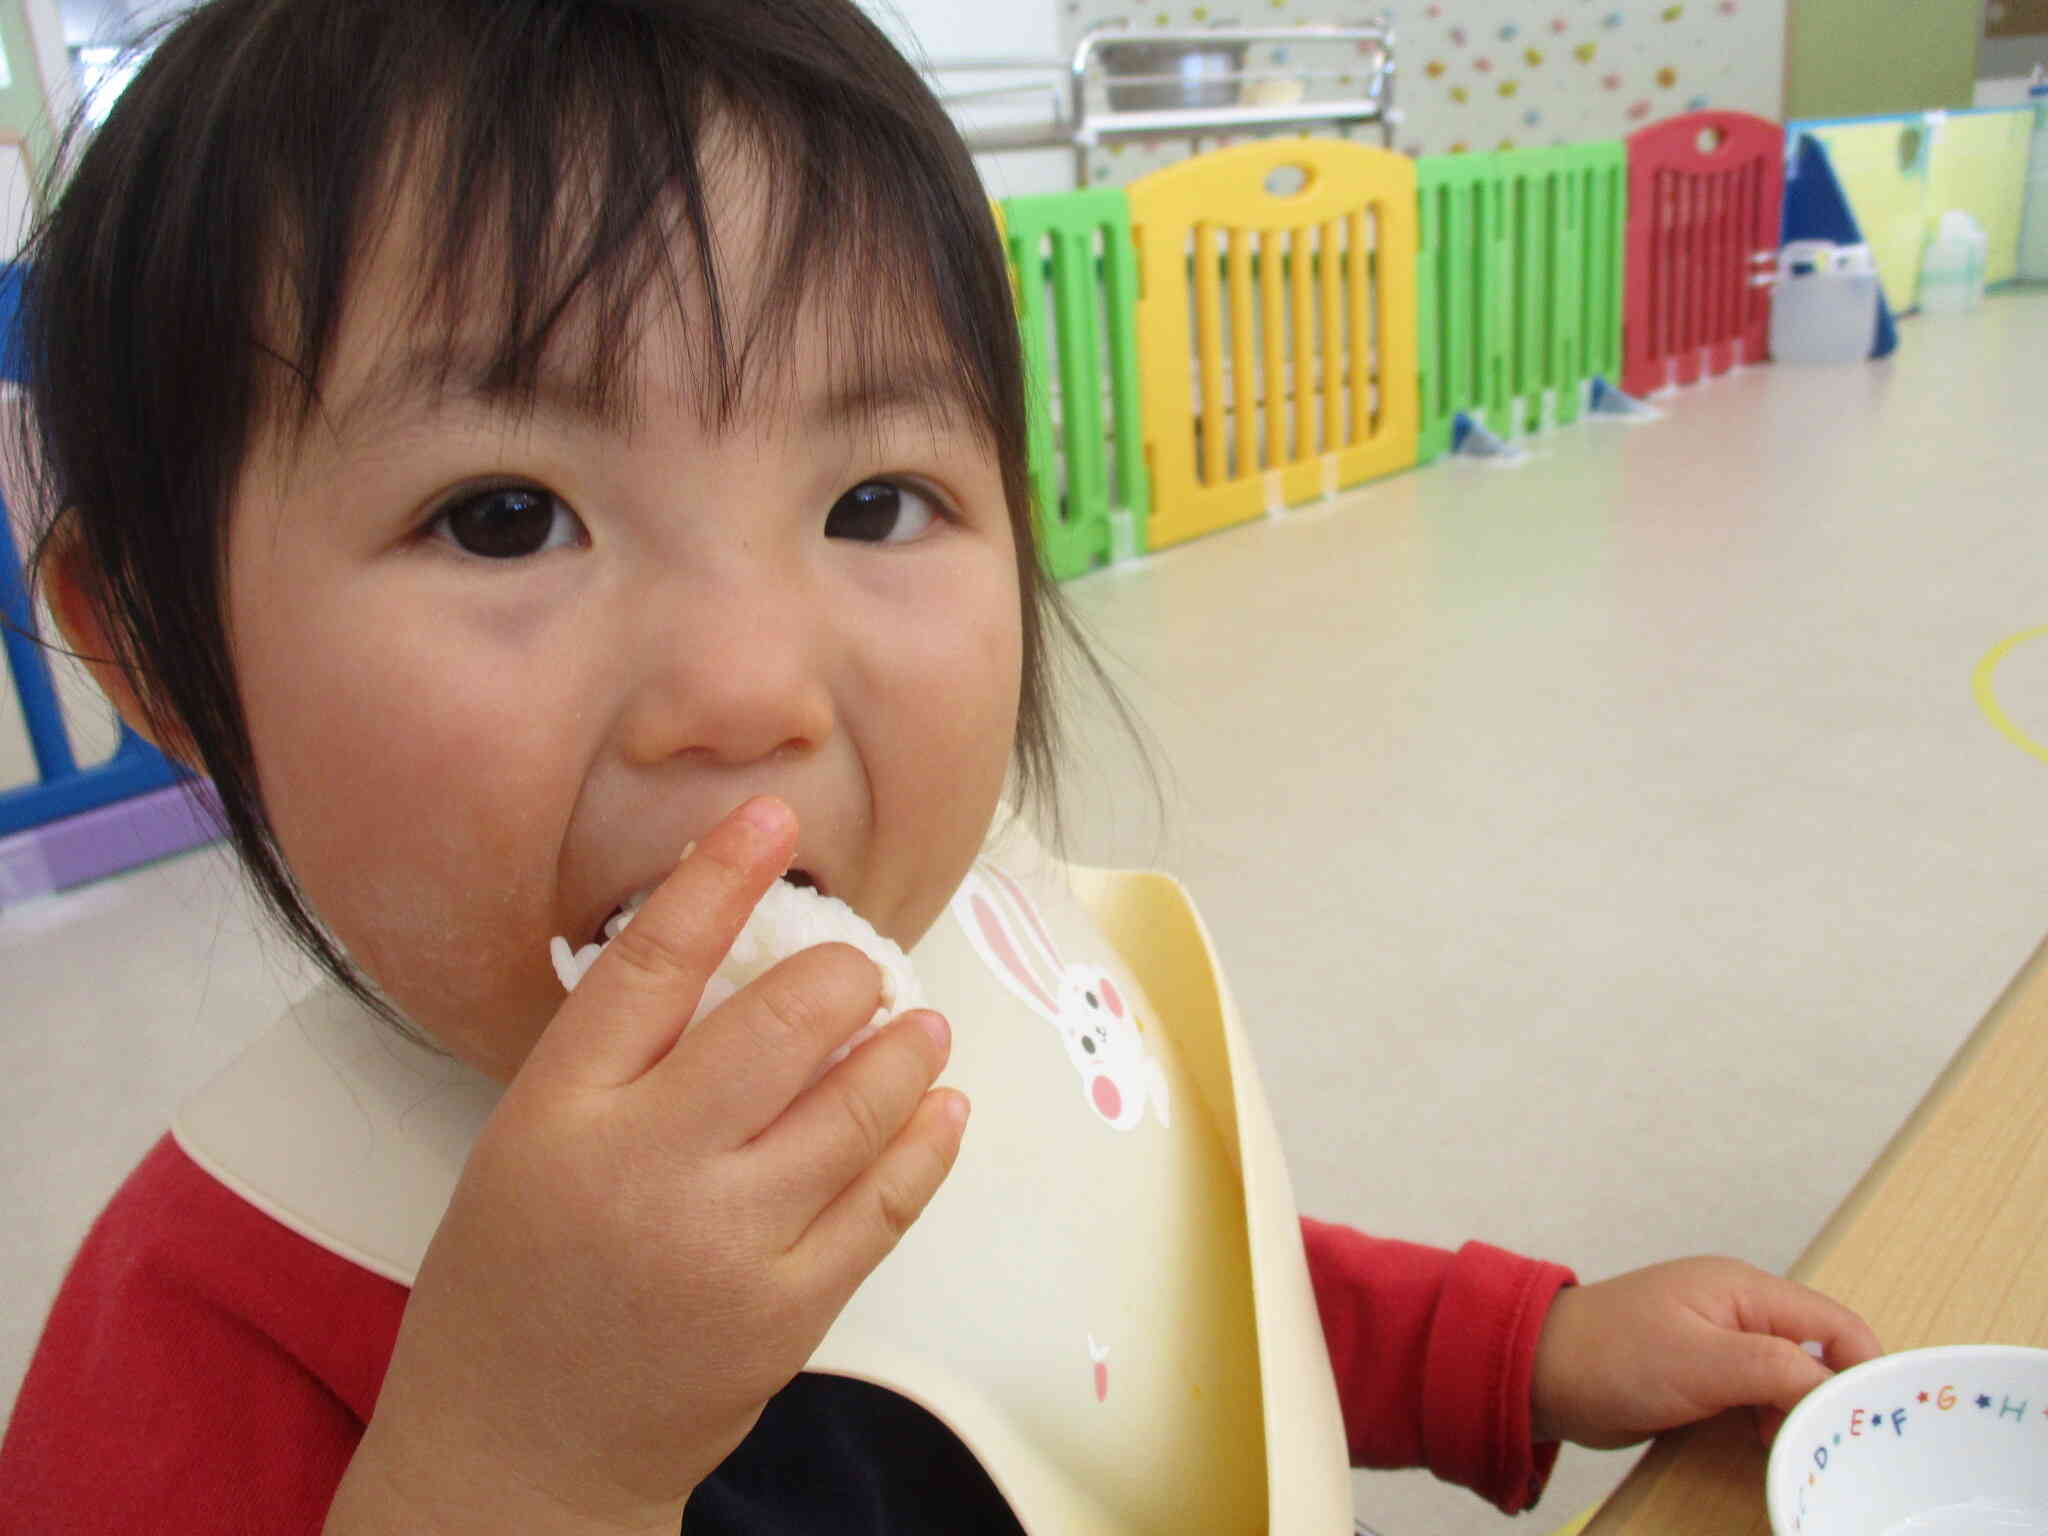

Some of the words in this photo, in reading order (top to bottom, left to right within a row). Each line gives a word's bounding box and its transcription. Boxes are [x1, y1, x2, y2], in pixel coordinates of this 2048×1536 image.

[1813, 1446, 1828, 1470] D
[1849, 1408, 1865, 1436] E
[1890, 1407, 1907, 1436] F
[1936, 1385, 1957, 1411] G
[1999, 1395, 2028, 1422] H
